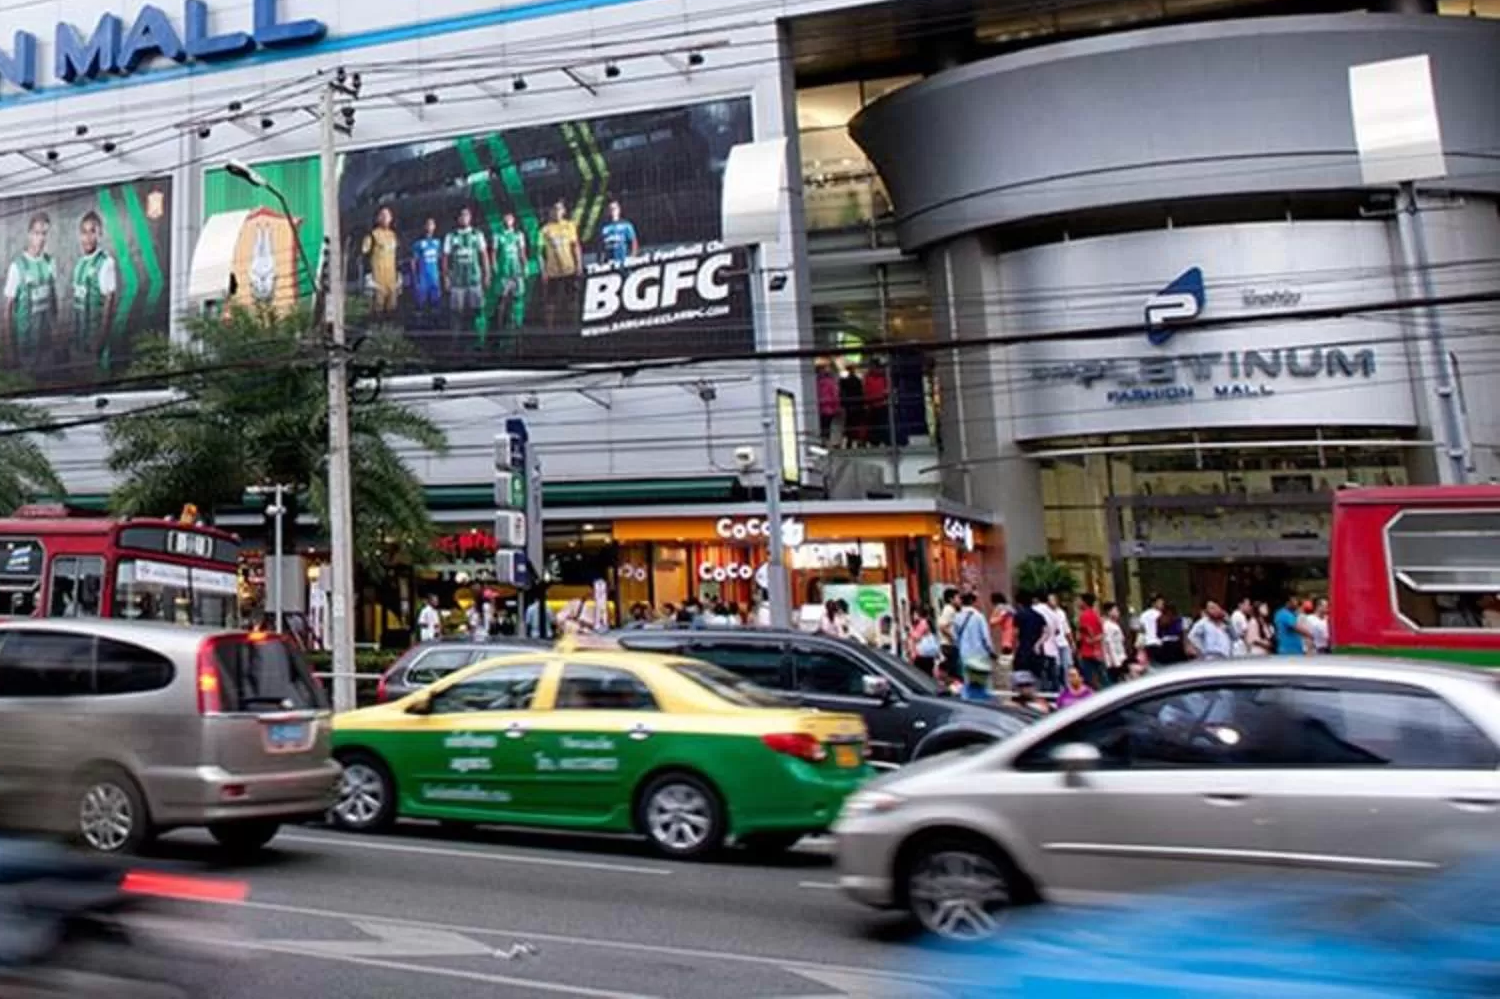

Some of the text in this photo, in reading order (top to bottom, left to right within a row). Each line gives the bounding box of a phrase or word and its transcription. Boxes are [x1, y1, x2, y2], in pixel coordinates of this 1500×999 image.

[581, 253, 733, 322] BGFC
[1106, 384, 1276, 403] FASHION MALL
